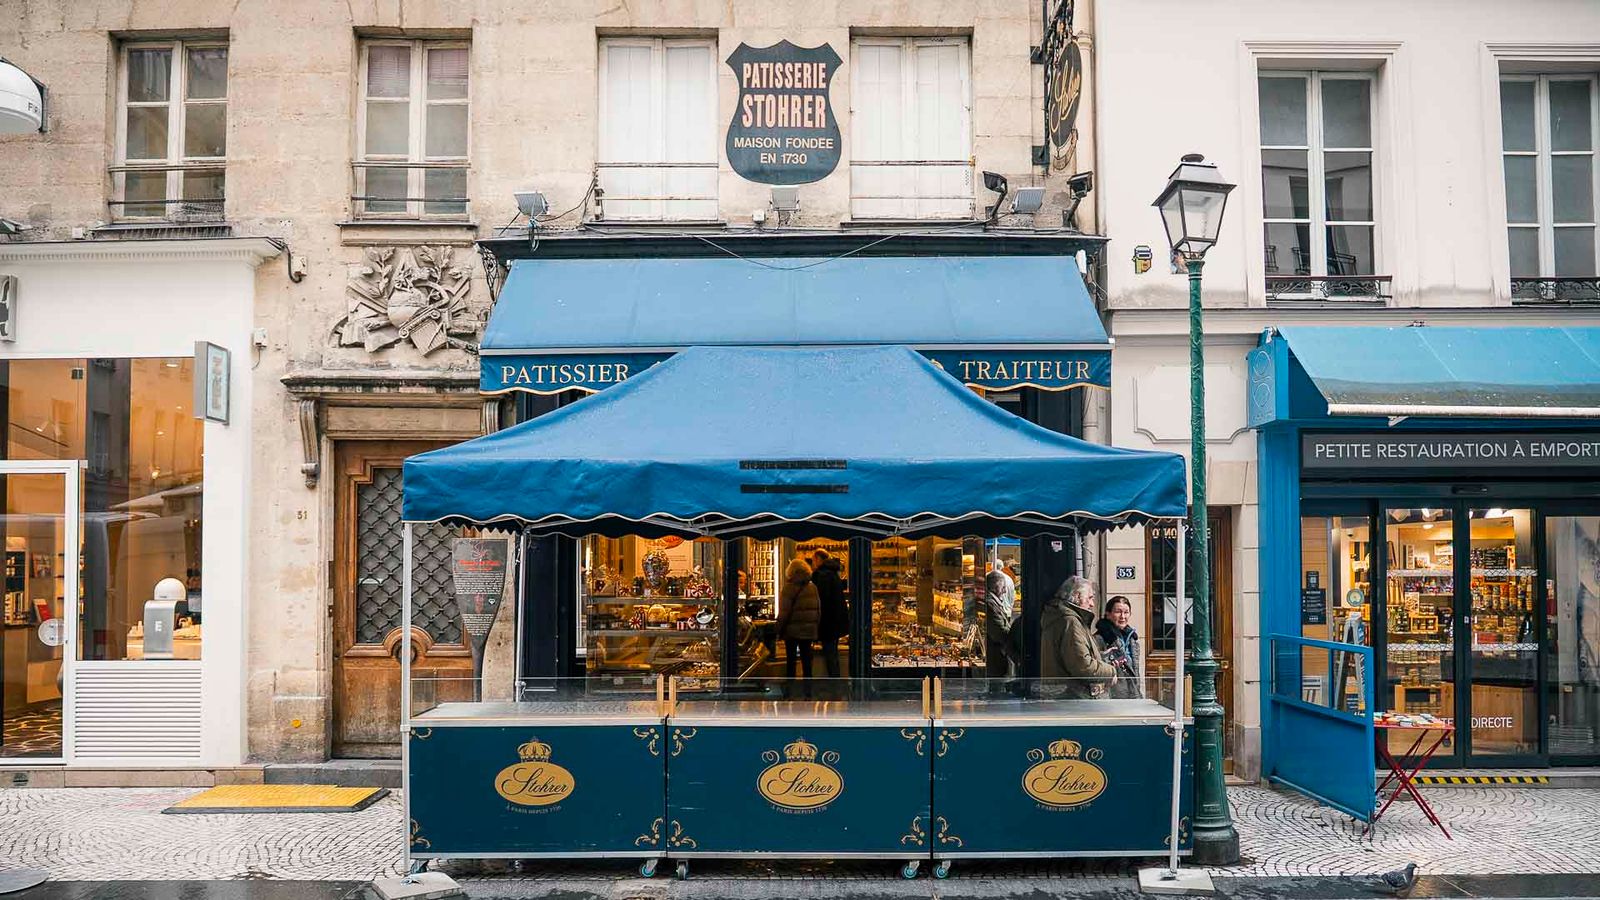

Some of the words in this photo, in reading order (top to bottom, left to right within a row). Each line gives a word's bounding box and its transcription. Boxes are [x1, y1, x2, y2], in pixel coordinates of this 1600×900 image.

[742, 62, 827, 89] PATISSERIE
[742, 93, 827, 128] STOHRER
[734, 137, 780, 149] MAISON
[785, 137, 834, 149] FONDEE
[760, 152, 777, 164] EN
[781, 153, 808, 165] 1730
[501, 364, 630, 385] PATISSIER
[959, 360, 1091, 380] TRAITEUR
[1315, 443, 1371, 458] PETITE
[1377, 443, 1508, 458] RESTAURATION
[1512, 440, 1525, 457] À
[1530, 442, 1600, 457] EMPORT
[1119, 568, 1133, 578] 53
[1471, 716, 1513, 729] DIRECTE
[502, 767, 569, 796] Stohrer
[767, 767, 834, 796] Stohrer
[1032, 765, 1098, 795] Stohrer
